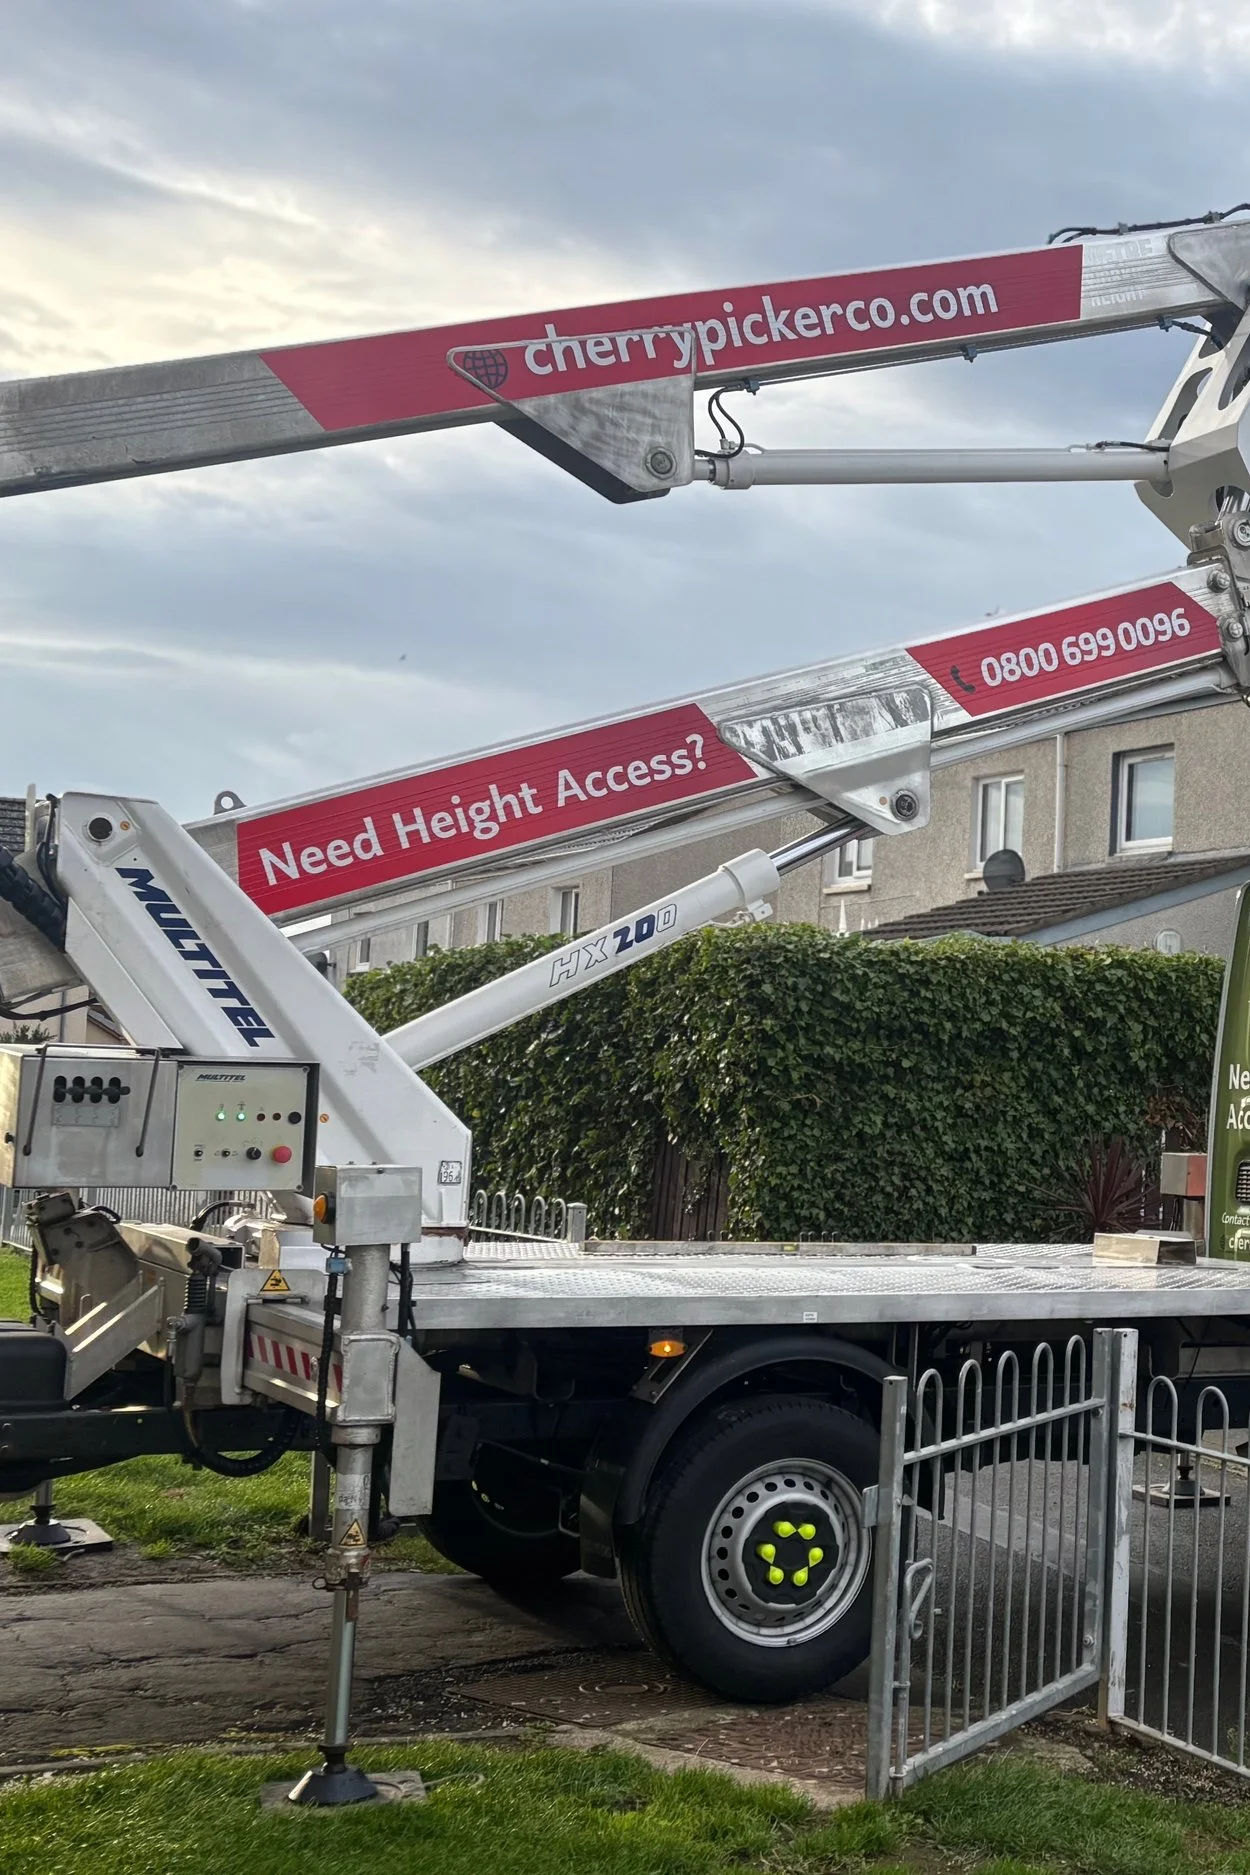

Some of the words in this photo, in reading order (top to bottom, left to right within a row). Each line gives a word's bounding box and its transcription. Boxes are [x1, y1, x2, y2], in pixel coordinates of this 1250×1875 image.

[524, 280, 1000, 376] cherrypickerco.com
[980, 641, 1060, 688] 0800
[1061, 626, 1116, 667] 699
[1116, 607, 1192, 652] 0096
[258, 816, 384, 886] Need
[391, 781, 543, 850] Height
[556, 732, 708, 808] Access?
[114, 866, 277, 1048] MULTITEL
[196, 1073, 247, 1082] MULTITEL
[1221, 1211, 1250, 1227] Contact
